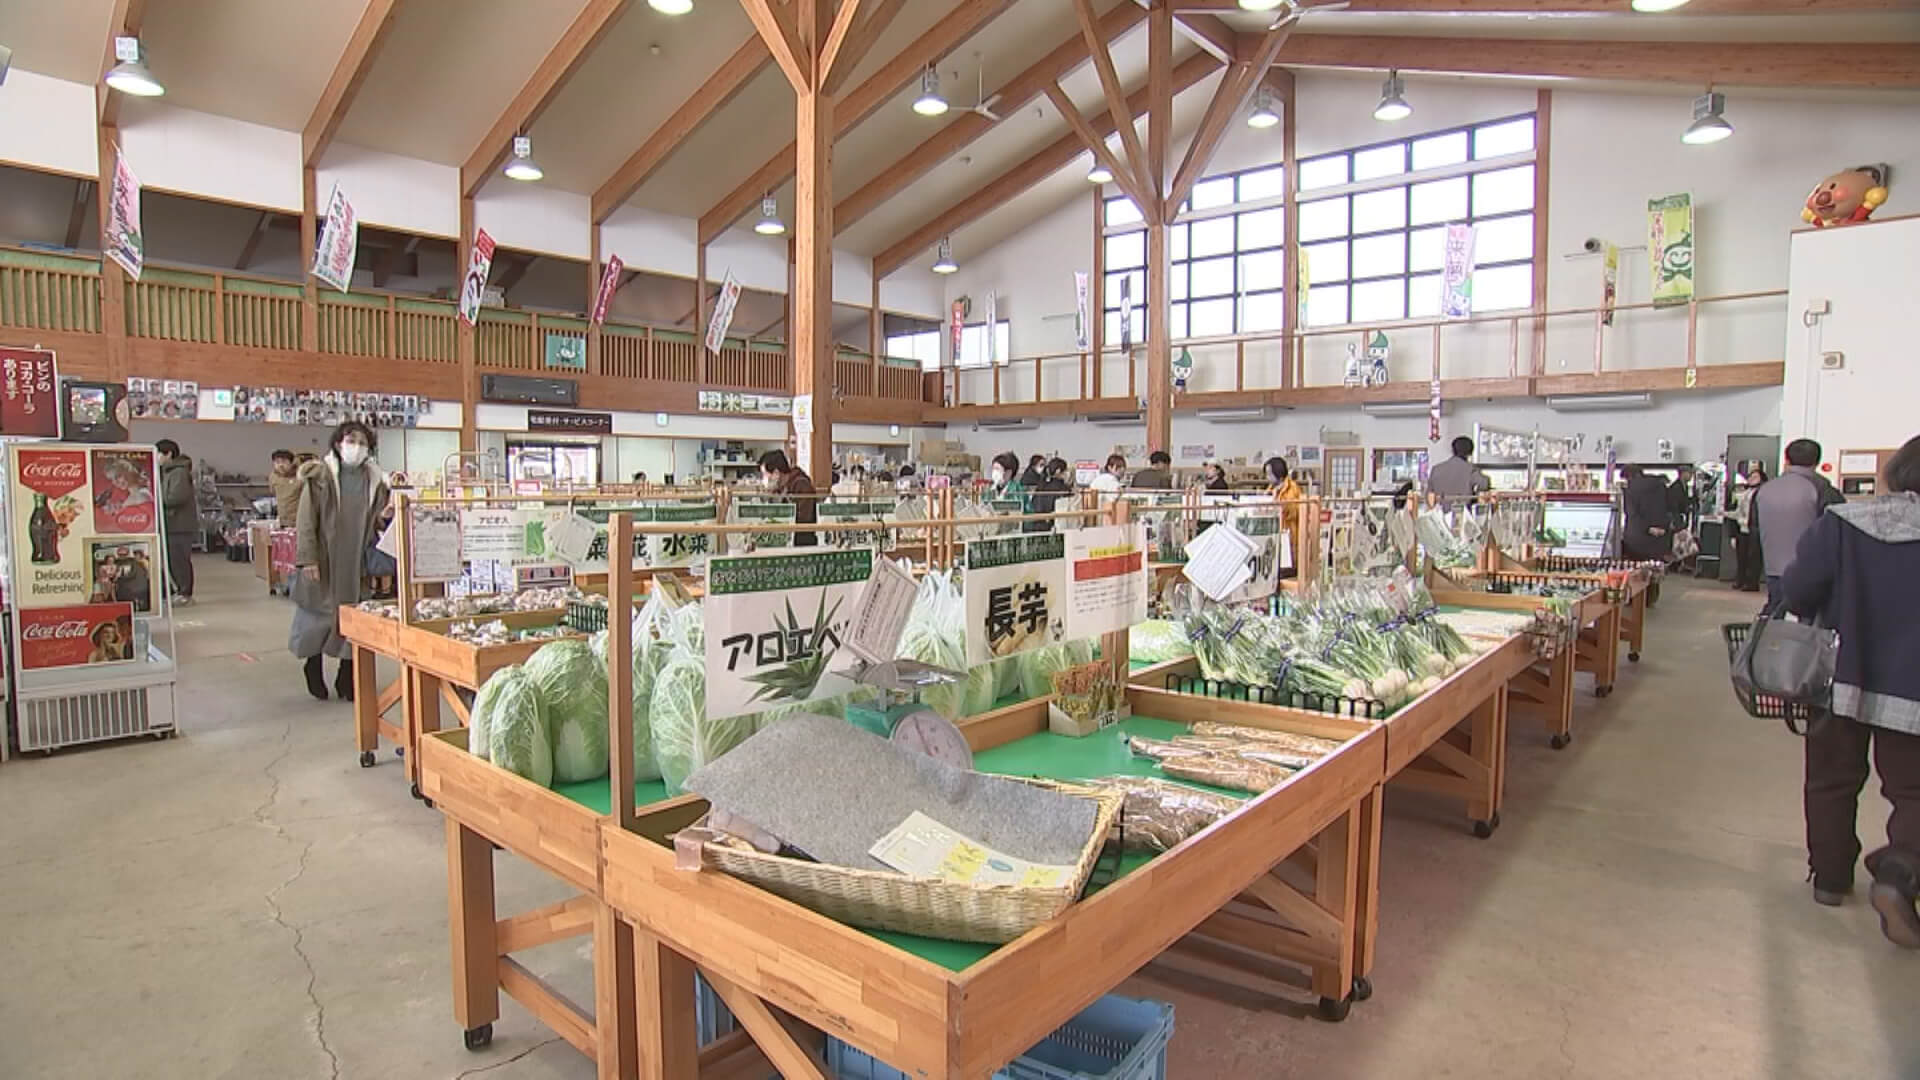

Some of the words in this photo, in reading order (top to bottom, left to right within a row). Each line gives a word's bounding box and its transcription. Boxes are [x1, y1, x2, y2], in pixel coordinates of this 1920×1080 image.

[20, 360, 36, 415] コカ・コーラ
[662, 532, 709, 556] 水菜
[35, 569, 81, 581] Delicious
[984, 582, 1048, 642] 長芋
[721, 618, 849, 671] アロエベ
